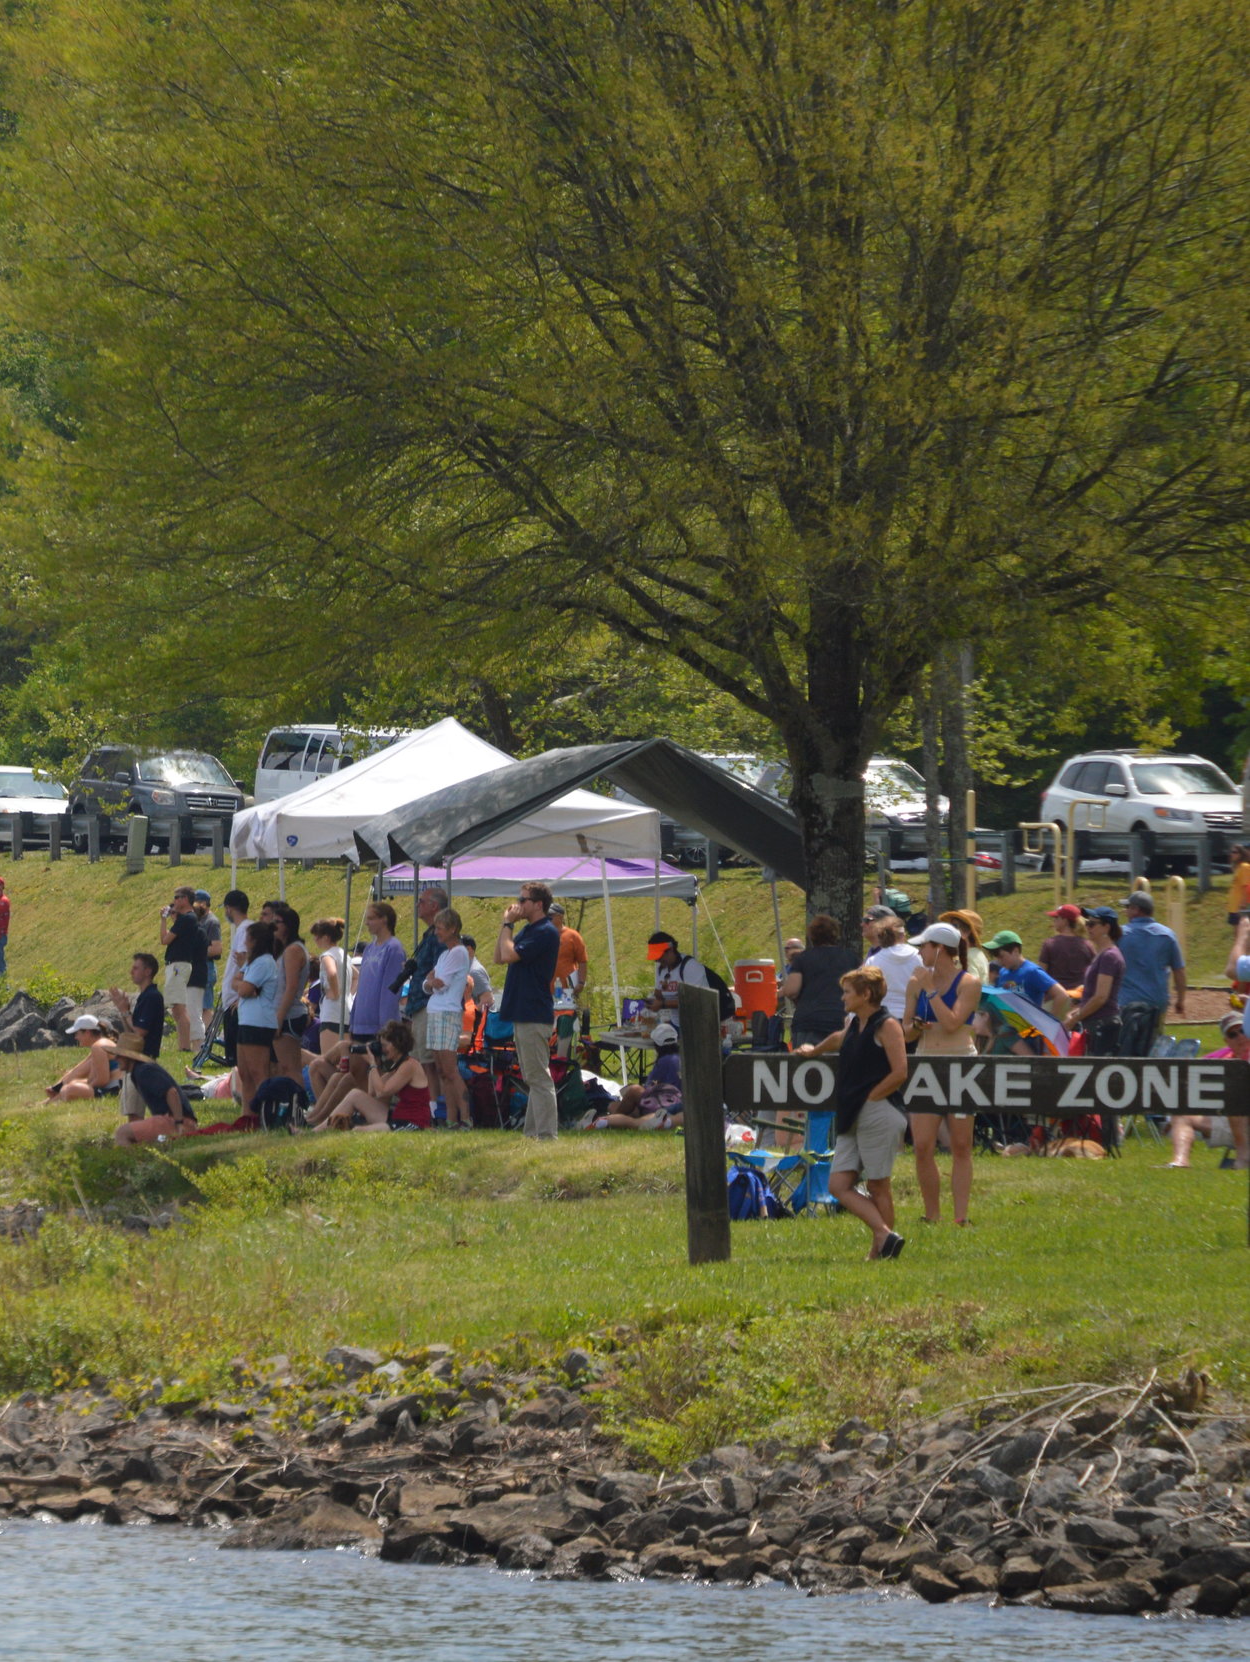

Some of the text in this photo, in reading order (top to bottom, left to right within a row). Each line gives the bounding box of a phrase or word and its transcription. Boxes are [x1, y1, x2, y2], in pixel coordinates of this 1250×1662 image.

[388, 880, 442, 892] WILDATS
[753, 1060, 1225, 1109] NO AKE ZONE
